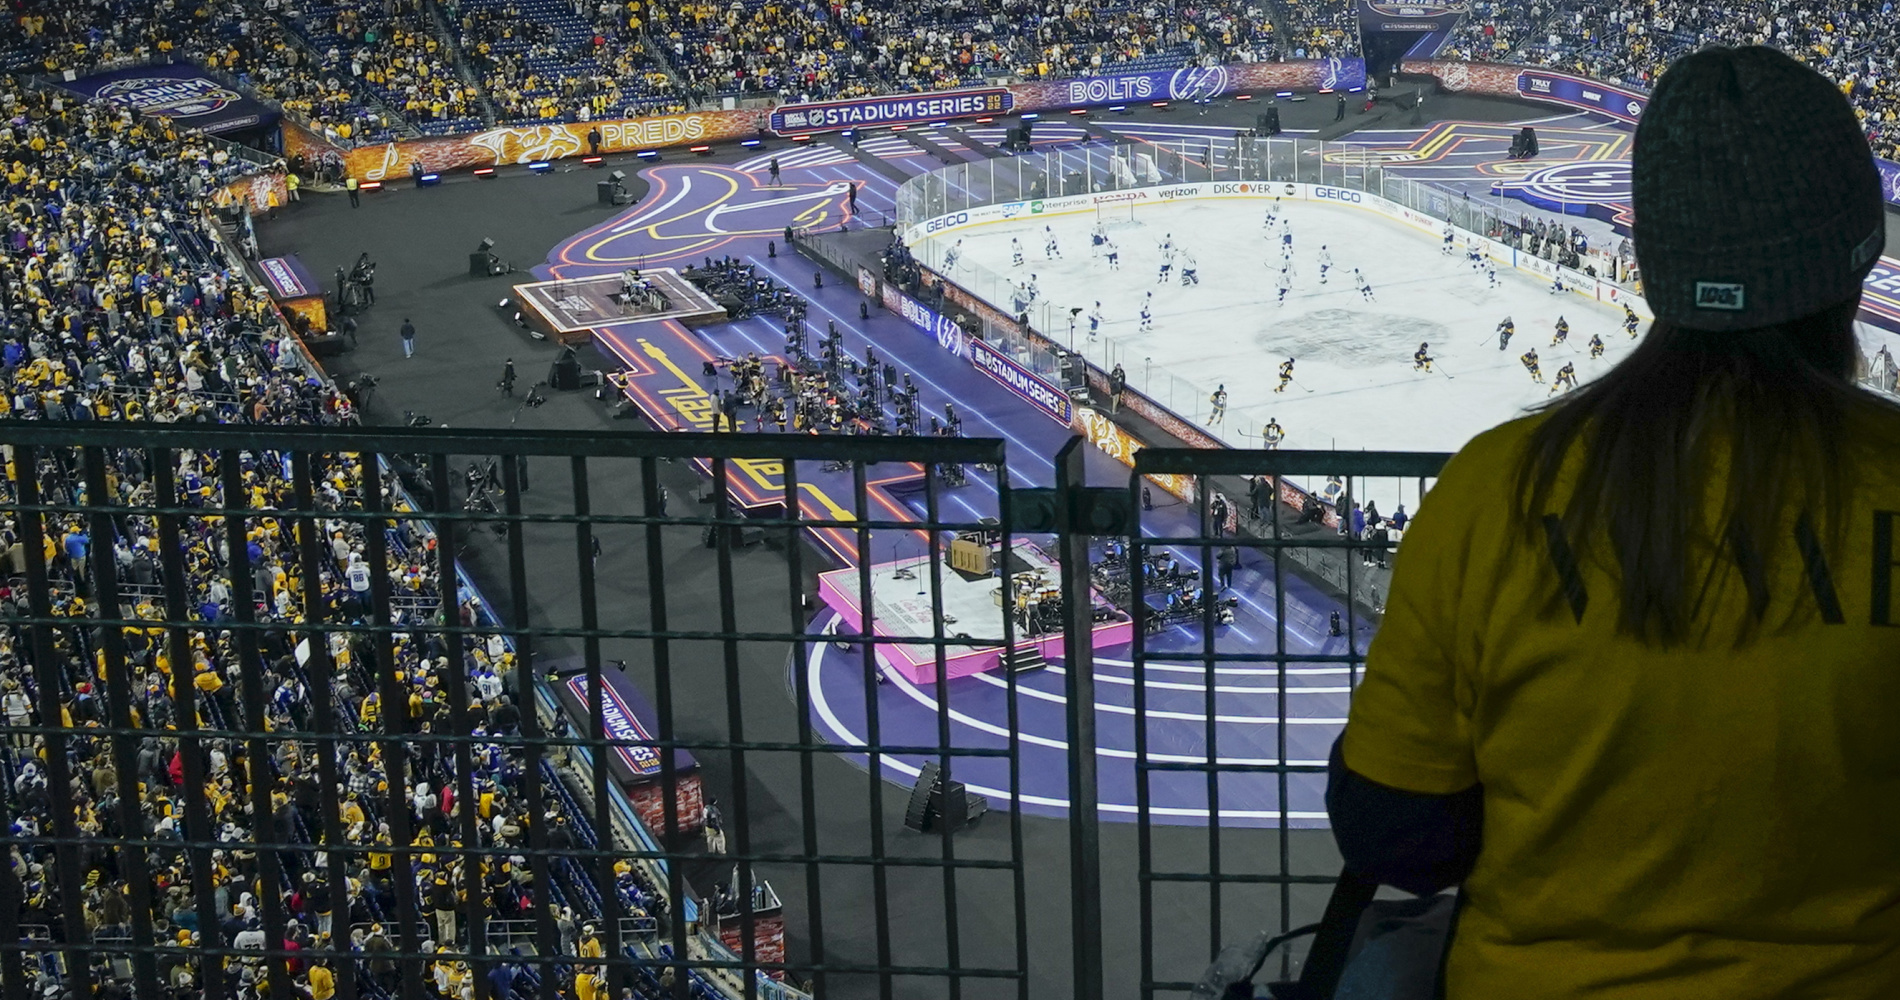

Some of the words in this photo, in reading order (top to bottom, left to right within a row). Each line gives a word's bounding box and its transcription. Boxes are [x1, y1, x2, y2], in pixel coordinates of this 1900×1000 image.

[90, 80, 213, 104] TADIUM
[1070, 75, 1151, 103] BOLTS
[131, 90, 203, 109] SERIES
[826, 103, 913, 125] STADIUM
[916, 96, 985, 117] SERIES
[602, 116, 704, 149] PREDS
[1093, 192, 1148, 204] HONDA
[1158, 187, 1198, 199] verizon
[1213, 184, 1271, 194] DISCOVER
[1315, 187, 1361, 203] GEICO
[1002, 204, 1021, 214] SAP
[926, 212, 968, 233] GEICO
[901, 299, 932, 332] BOLTS
[992, 358, 1029, 394] STADIUM
[1028, 380, 1059, 413] SERIES
[482, 683, 492, 695] 91
